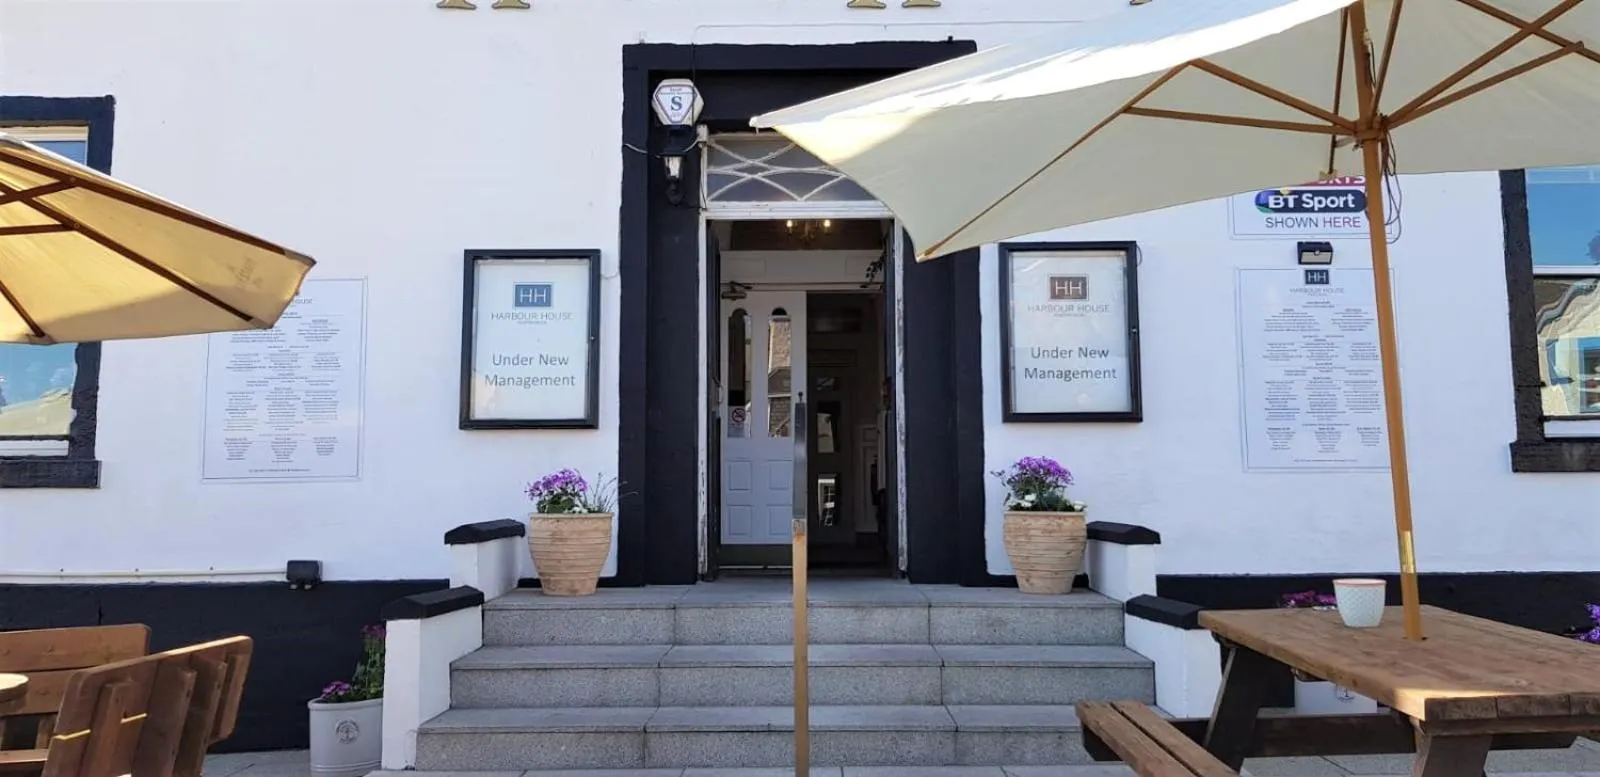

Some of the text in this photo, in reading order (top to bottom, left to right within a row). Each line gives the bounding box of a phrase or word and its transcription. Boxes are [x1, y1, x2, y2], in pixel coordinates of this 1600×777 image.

[671, 95, 682, 111] S
[1268, 193, 1356, 212] BT Sport
[1265, 216, 1361, 228] SHOWN HERE
[519, 287, 547, 304] HH
[1054, 280, 1082, 296] HH
[490, 311, 574, 321] HARBOUR HOUSE
[1027, 303, 1110, 313] HARBOUR HOUSE
[491, 353, 570, 366] Under New
[1031, 346, 1110, 359] Under New
[484, 373, 576, 389] Management
[1024, 366, 1117, 382] Management
